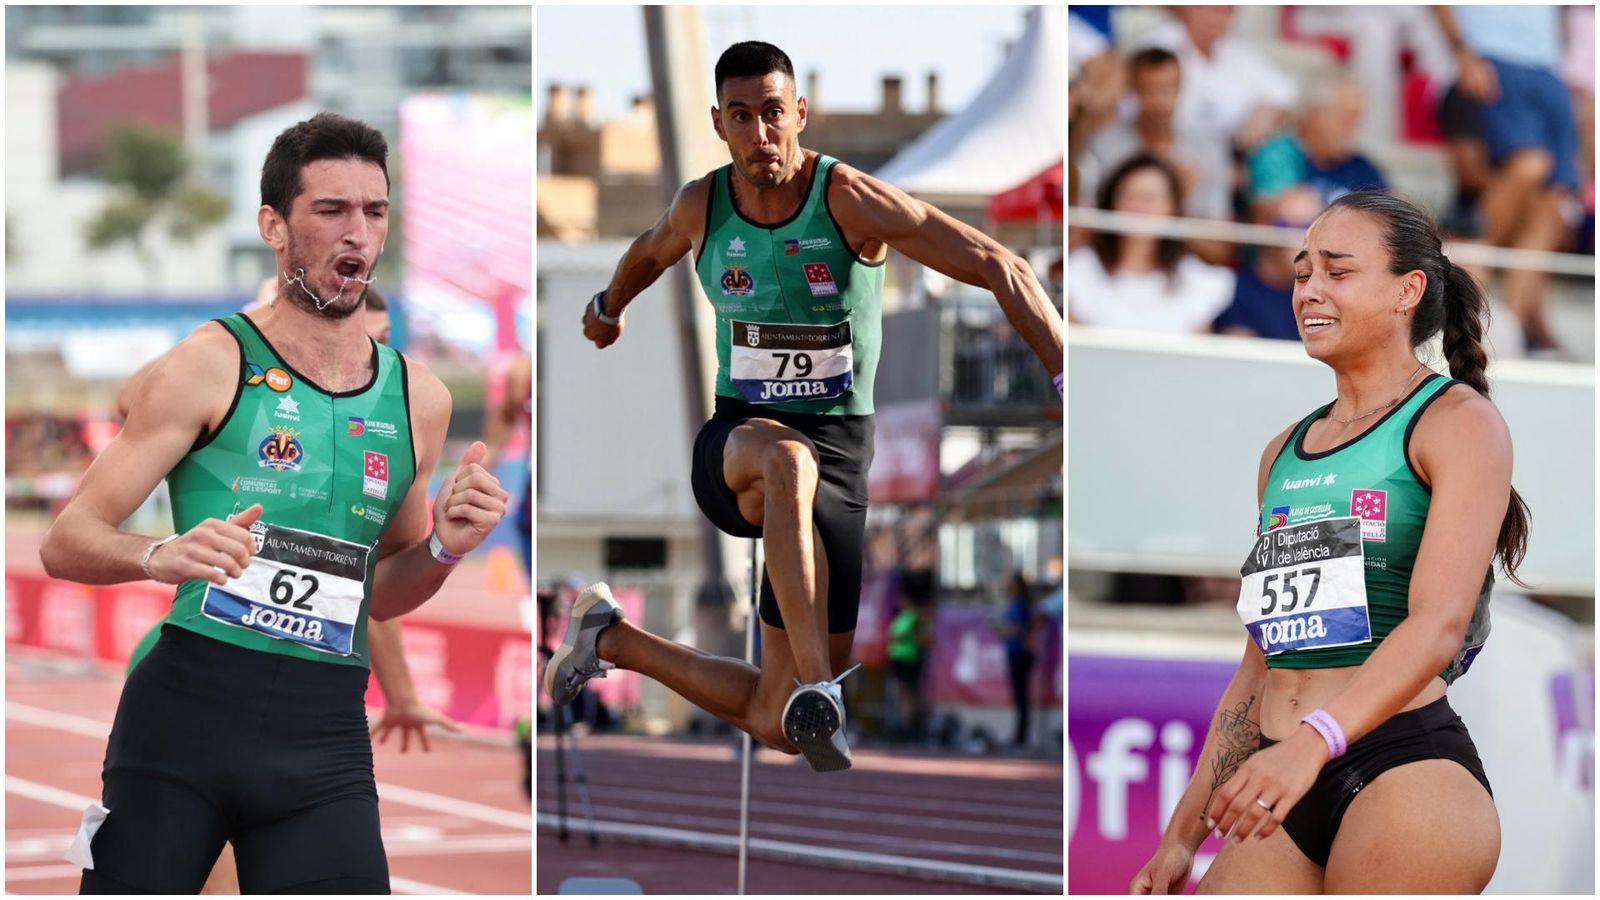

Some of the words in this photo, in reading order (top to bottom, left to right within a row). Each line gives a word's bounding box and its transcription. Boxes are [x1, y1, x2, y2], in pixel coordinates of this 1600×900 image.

[808, 332, 840, 342] TORRENT
[772, 353, 813, 378] 79
[274, 410, 300, 422] luanvi
[1281, 474, 1323, 491] luanvi
[1277, 526, 1320, 548] Diputació
[265, 538, 322, 558] AJUNTAMENT
[324, 551, 358, 567] TORRENT
[1278, 551, 1291, 565] de
[1292, 544, 1330, 562] València
[269, 569, 320, 612] 62
[1261, 567, 1322, 616] 557
